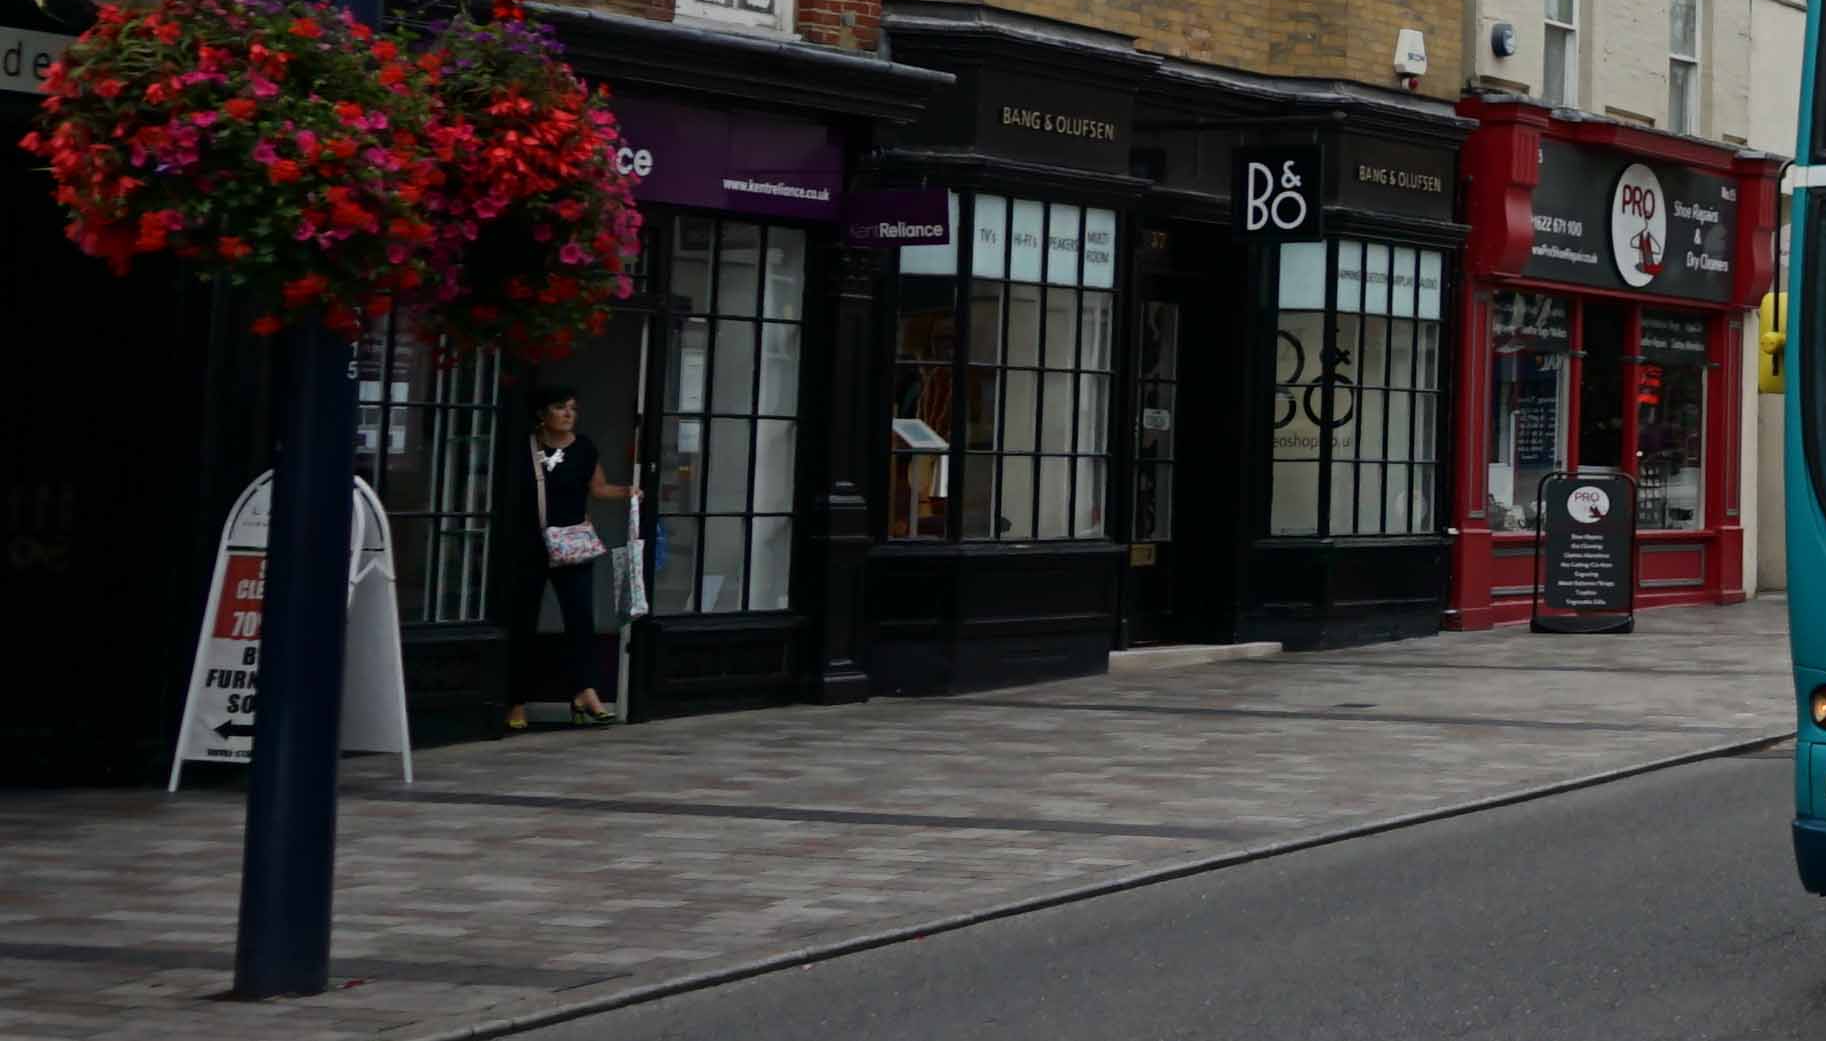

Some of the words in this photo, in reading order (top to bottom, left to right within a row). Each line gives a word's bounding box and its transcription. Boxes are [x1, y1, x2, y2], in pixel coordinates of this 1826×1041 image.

[1002, 106, 1041, 130] BANG
[1043, 114, 1053, 132] &
[1055, 116, 1115, 141] OLUFSEN
[721, 177, 832, 202] www.kentreliance.co.uk
[1358, 164, 1387, 185] BANG
[1389, 169, 1397, 186] &
[1399, 169, 1441, 193] OLUFSEN
[1622, 184, 1656, 220] PRO
[1574, 491, 1600, 502] PRO
